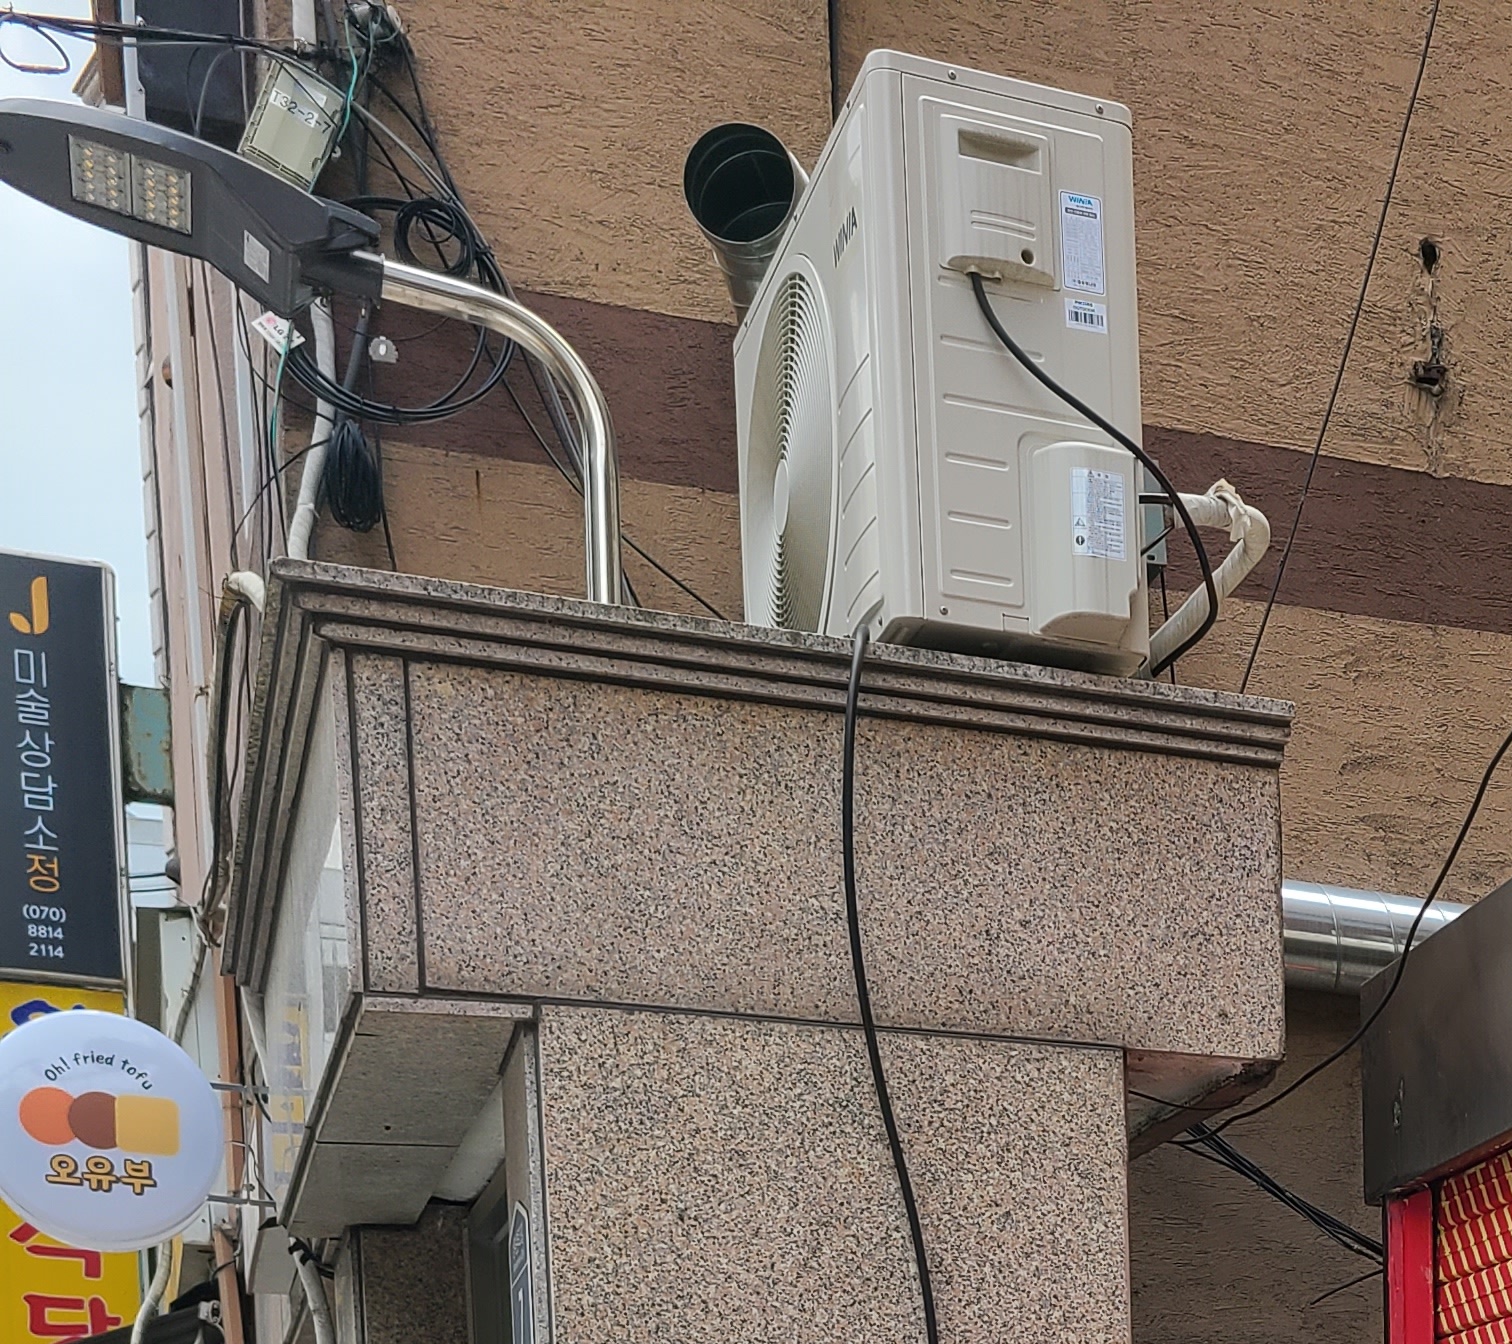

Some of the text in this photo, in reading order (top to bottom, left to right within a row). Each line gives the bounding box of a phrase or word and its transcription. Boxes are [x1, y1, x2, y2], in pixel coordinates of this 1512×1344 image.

[272, 89, 331, 134] T32-2-7
[833, 206, 858, 268] WINIA
[22, 903, 67, 923] (070)
[27, 923, 64, 941] 8814
[28, 942, 65, 959] 2114
[44, 1050, 153, 1090] Oh! fried tofu
[45, 1153, 157, 1196] 오유부
